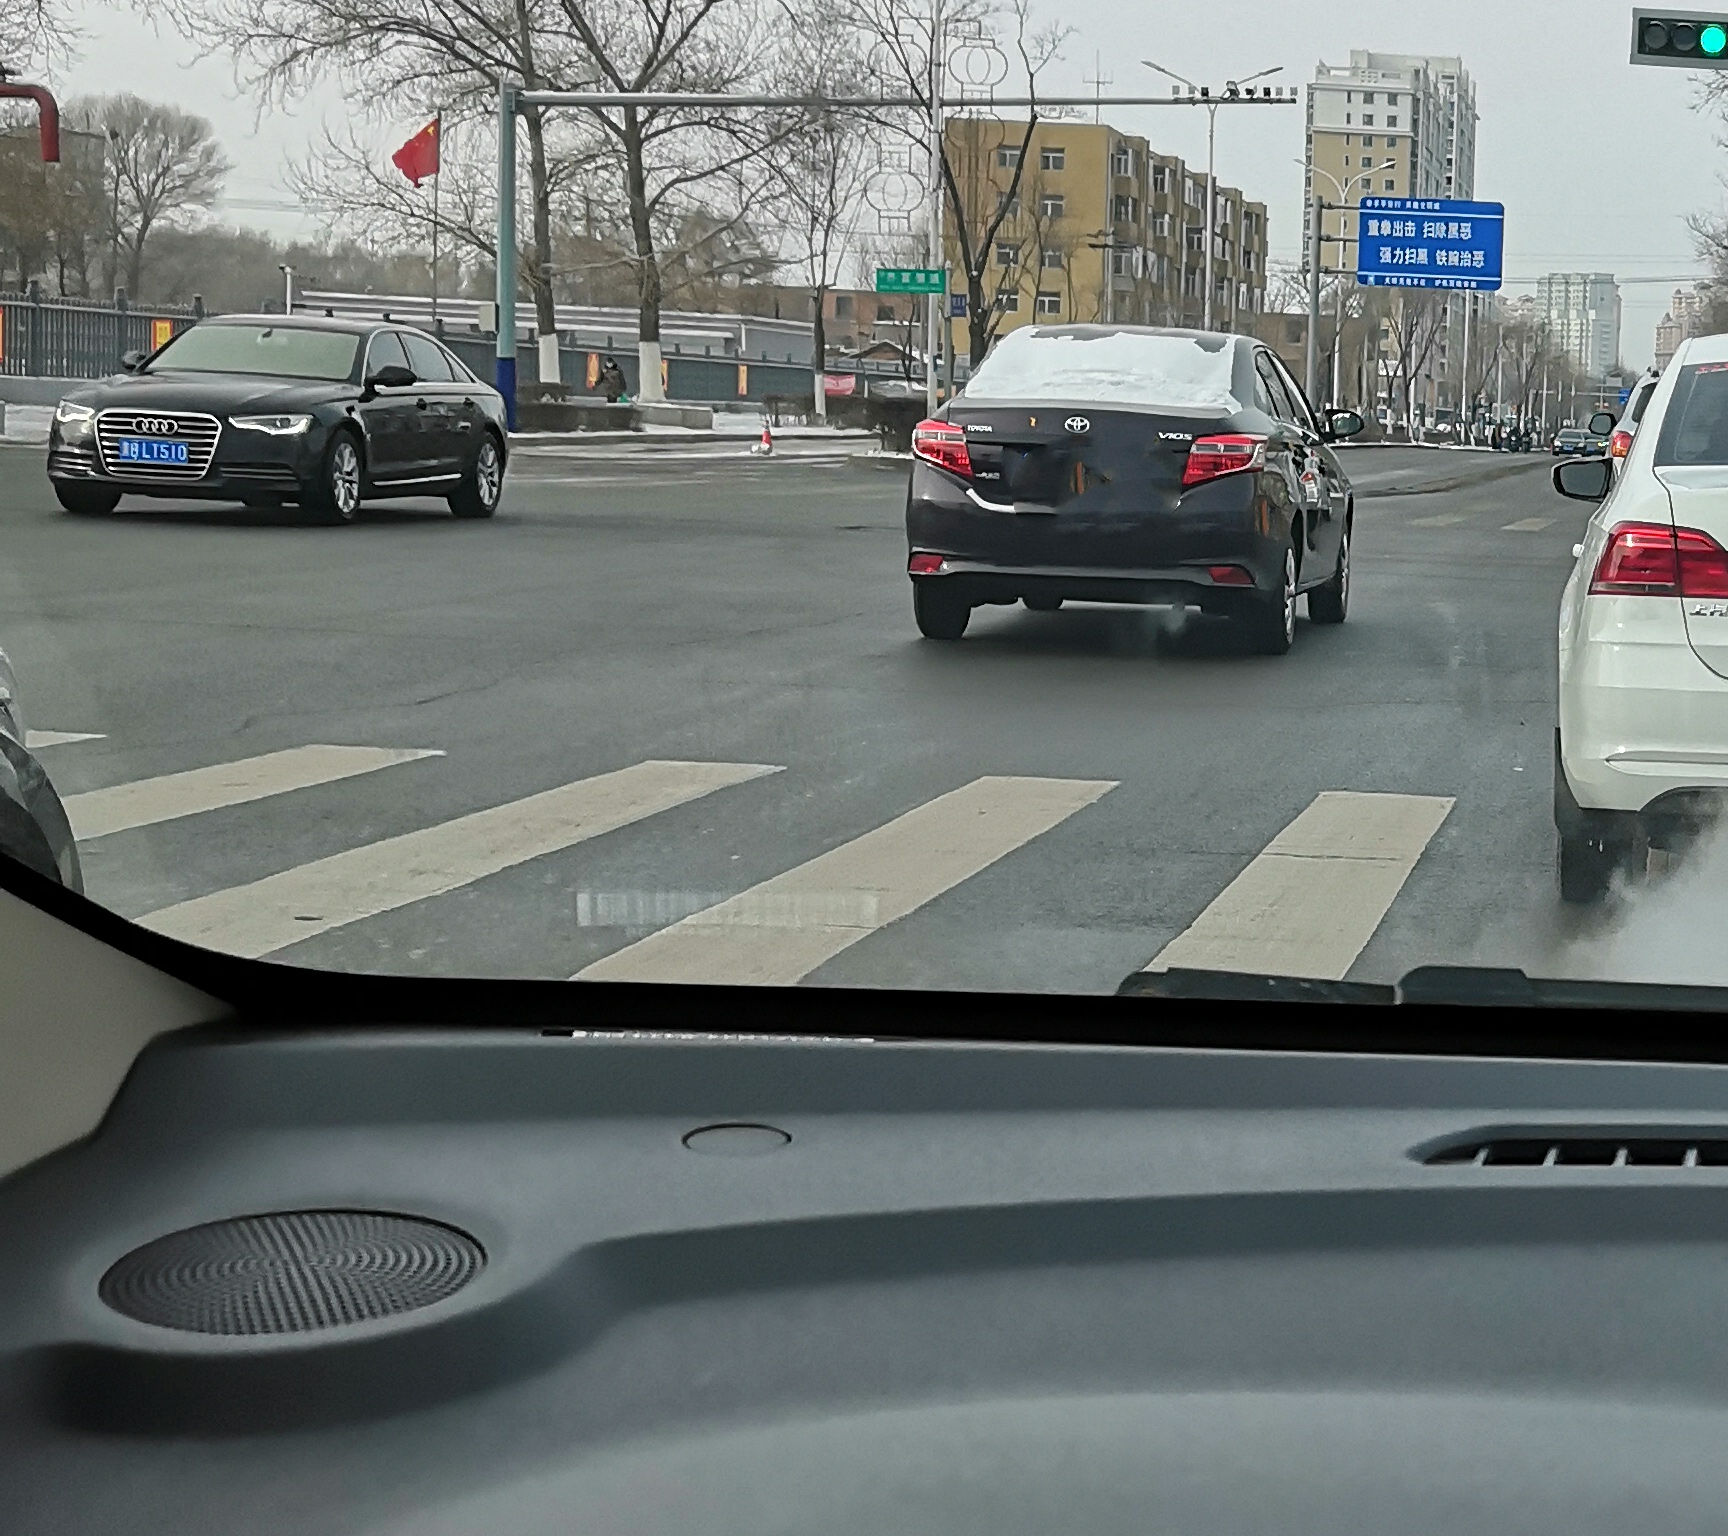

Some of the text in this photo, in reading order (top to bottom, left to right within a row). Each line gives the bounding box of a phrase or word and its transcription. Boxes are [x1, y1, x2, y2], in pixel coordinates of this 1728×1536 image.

[1367, 219, 1472, 240] 重拳出击 扫除黑恶
[1379, 247, 1485, 268] 强力扫黑 铁腕治恶
[1158, 432, 1193, 441] VIOS
